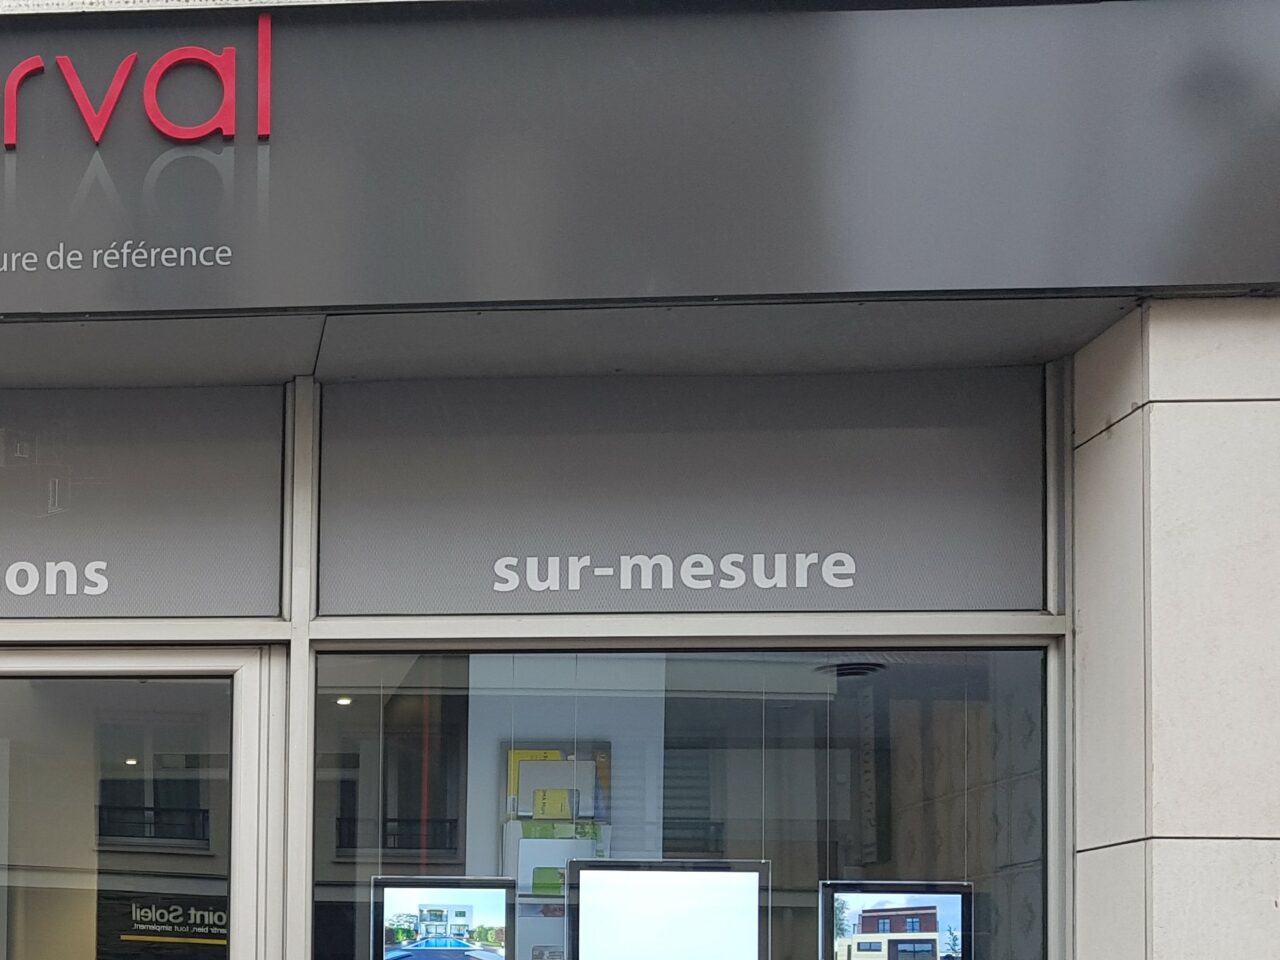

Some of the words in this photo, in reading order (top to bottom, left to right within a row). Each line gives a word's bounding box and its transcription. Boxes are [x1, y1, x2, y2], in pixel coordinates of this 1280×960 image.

[46, 243, 83, 271] de
[92, 240, 233, 269] référence
[493, 551, 856, 591] sur-mesure
